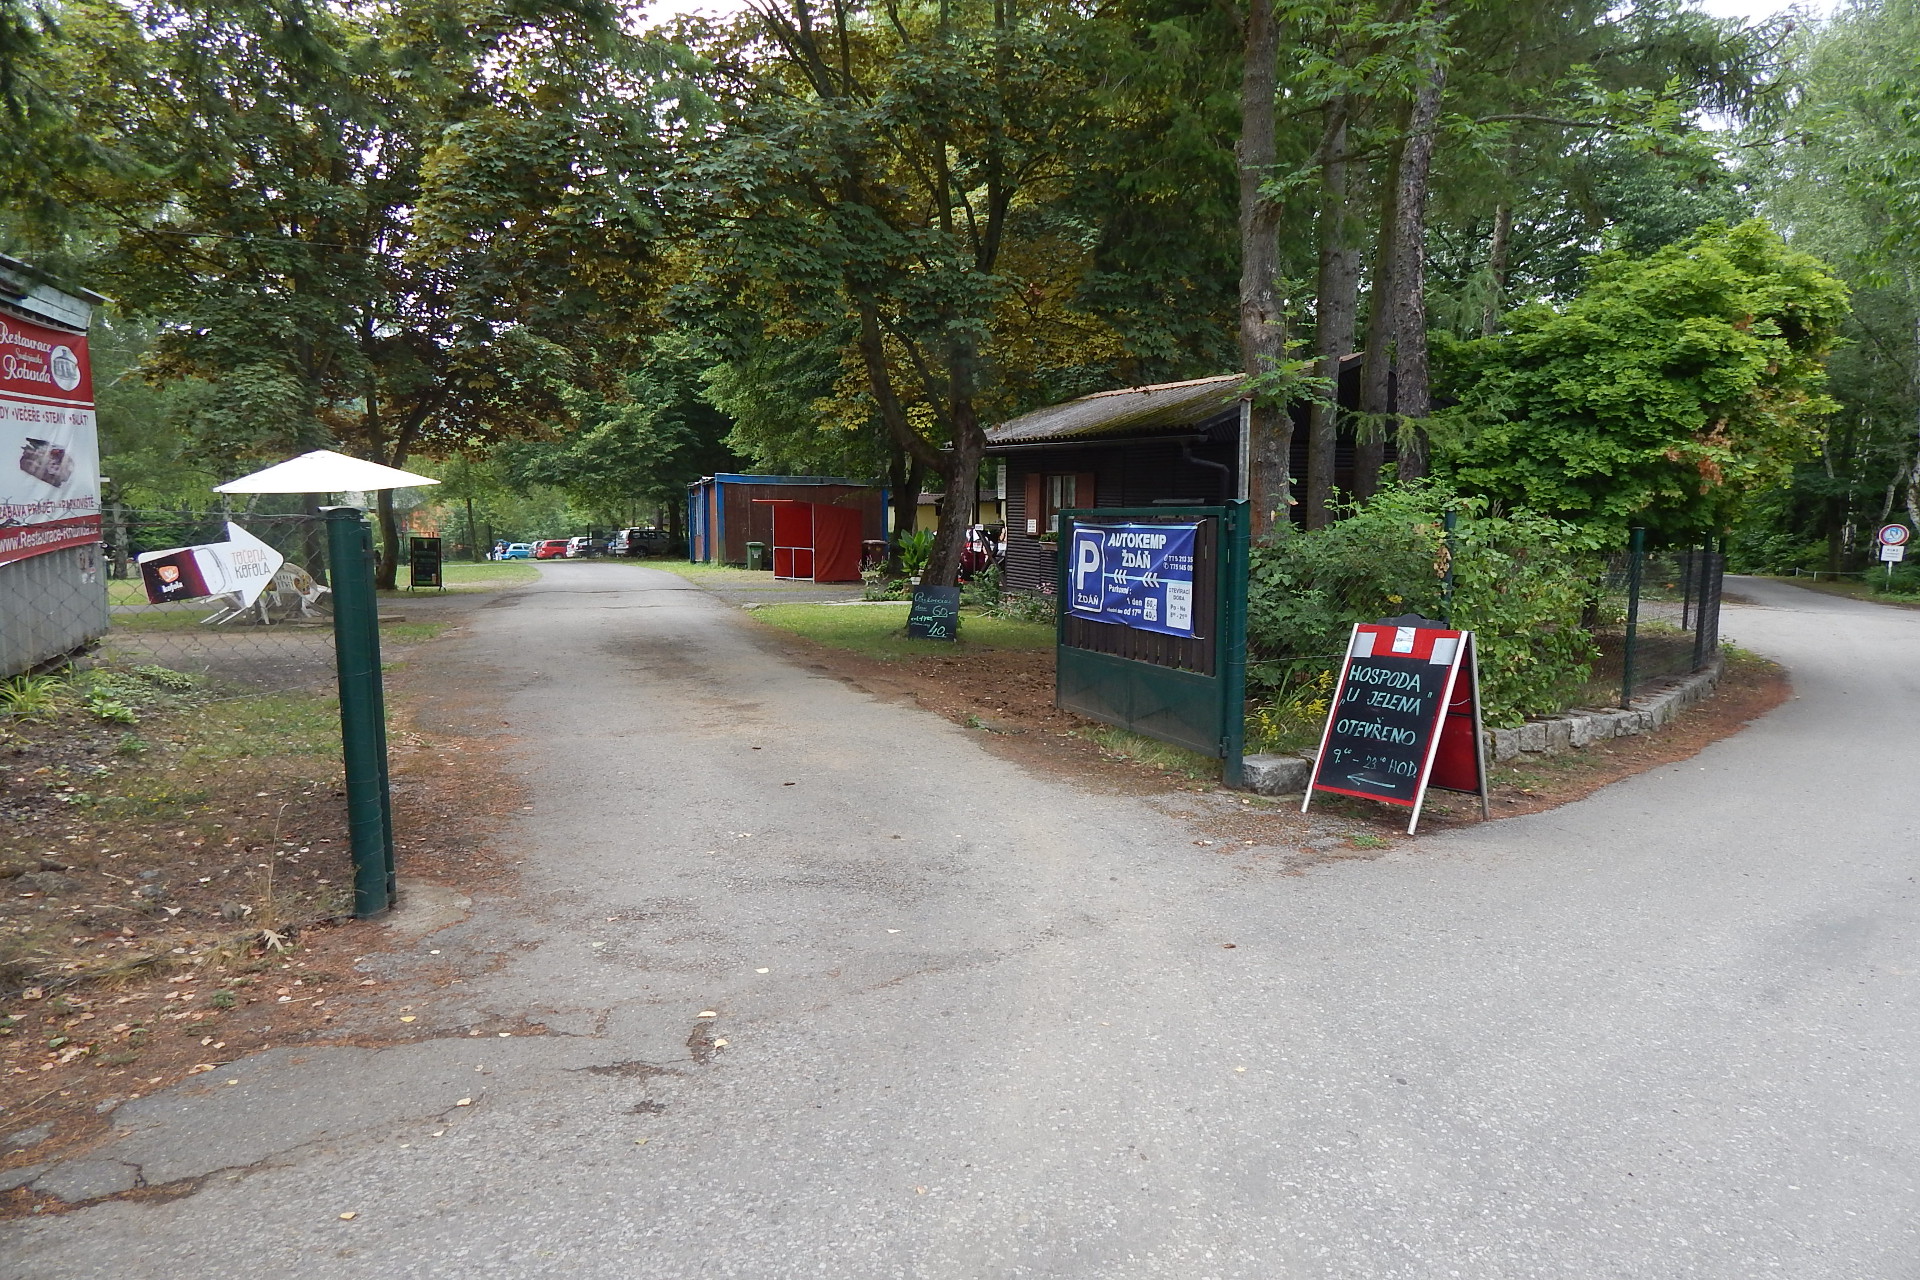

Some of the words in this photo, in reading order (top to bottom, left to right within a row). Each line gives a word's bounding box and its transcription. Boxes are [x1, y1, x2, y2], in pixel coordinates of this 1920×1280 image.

[0, 321, 52, 353] Restaurace
[3, 355, 52, 383] Rotunda
[15, 406, 41, 422] VEČEŘE
[1107, 532, 1167, 550] AUTOKEMP
[1076, 540, 1100, 590] P
[1121, 549, 1151, 569] ŽDÁŇ
[234, 563, 271, 579] KOFOLA
[1077, 592, 1099, 605] ŽDÁŇ
[1123, 607, 1131, 616] od
[1348, 664, 1420, 692] HOSPODA
[1336, 717, 1416, 746] OTEVŘENO
